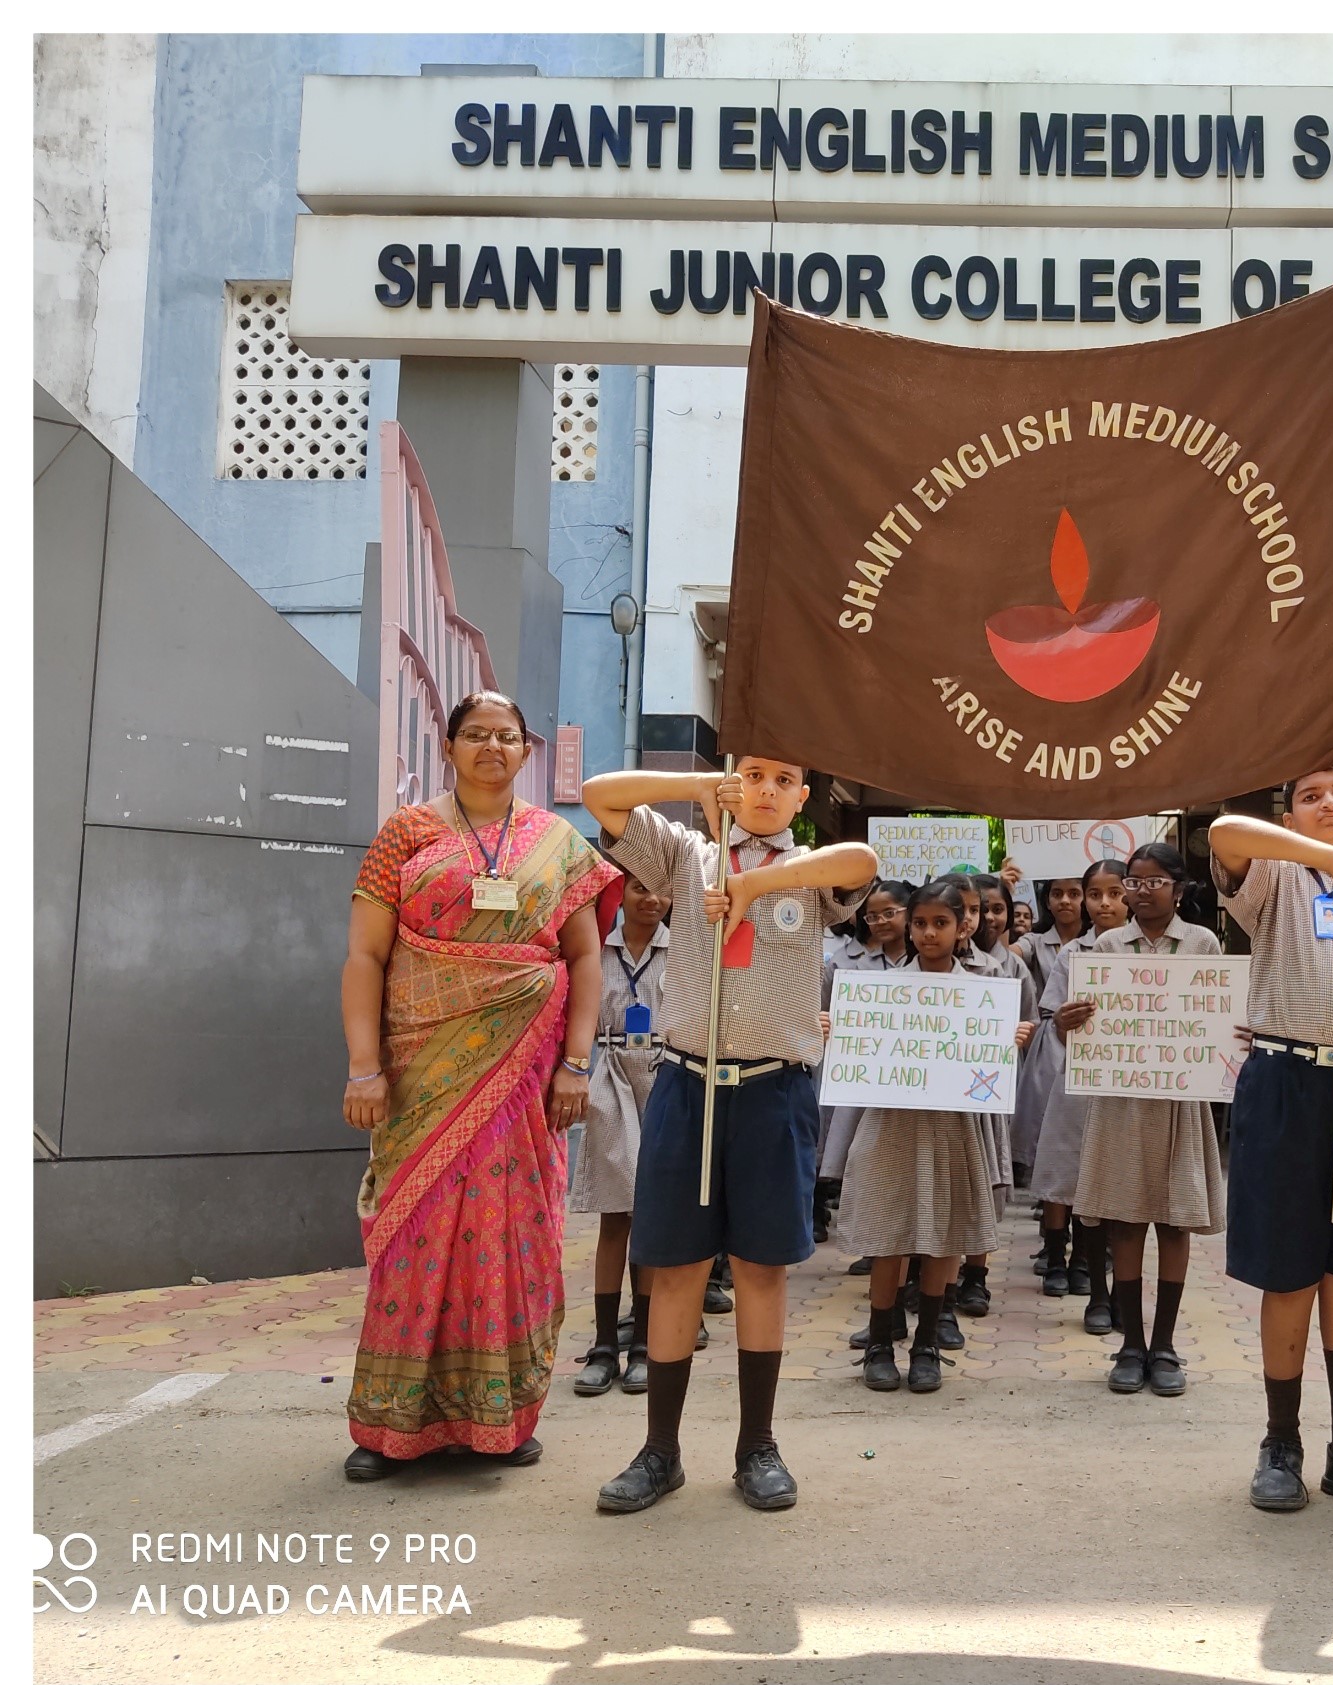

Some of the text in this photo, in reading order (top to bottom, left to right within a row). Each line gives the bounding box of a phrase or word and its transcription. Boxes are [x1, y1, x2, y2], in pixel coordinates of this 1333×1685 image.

[451, 103, 693, 169] SHANTI
[719, 107, 992, 175] ENGLISH
[1018, 111, 1265, 178] MEDIUM
[374, 243, 622, 312] SHANTI
[650, 250, 888, 319] JUNIOR
[911, 255, 1201, 324] COLLEGE
[1232, 259, 1313, 319] OF
[838, 401, 1306, 634] SHANTI ENGLISH MEDIUM SCHOOL
[931, 670, 1204, 781] ARISE AND SHINE
[876, 824, 932, 845] REDUCE,
[1011, 822, 1080, 845] FUTURE
[918, 843, 977, 861] RECYCLE
[1086, 966, 1231, 987] IF YOU ARE
[837, 982, 995, 1009] PLASTICS GIVE A
[1178, 994, 1231, 1013] THEN
[836, 1010, 1004, 1041] HELPFUL HAND, BUT
[1100, 1018, 1206, 1037] SOMETHING
[834, 1036, 1015, 1065] THEY ARE POLLUTING
[1155, 1045, 1176, 1063] TO
[1183, 1046, 1217, 1064] CUT
[830, 1063, 927, 1091] OUR LAND!
[1071, 1068, 1102, 1087] THE
